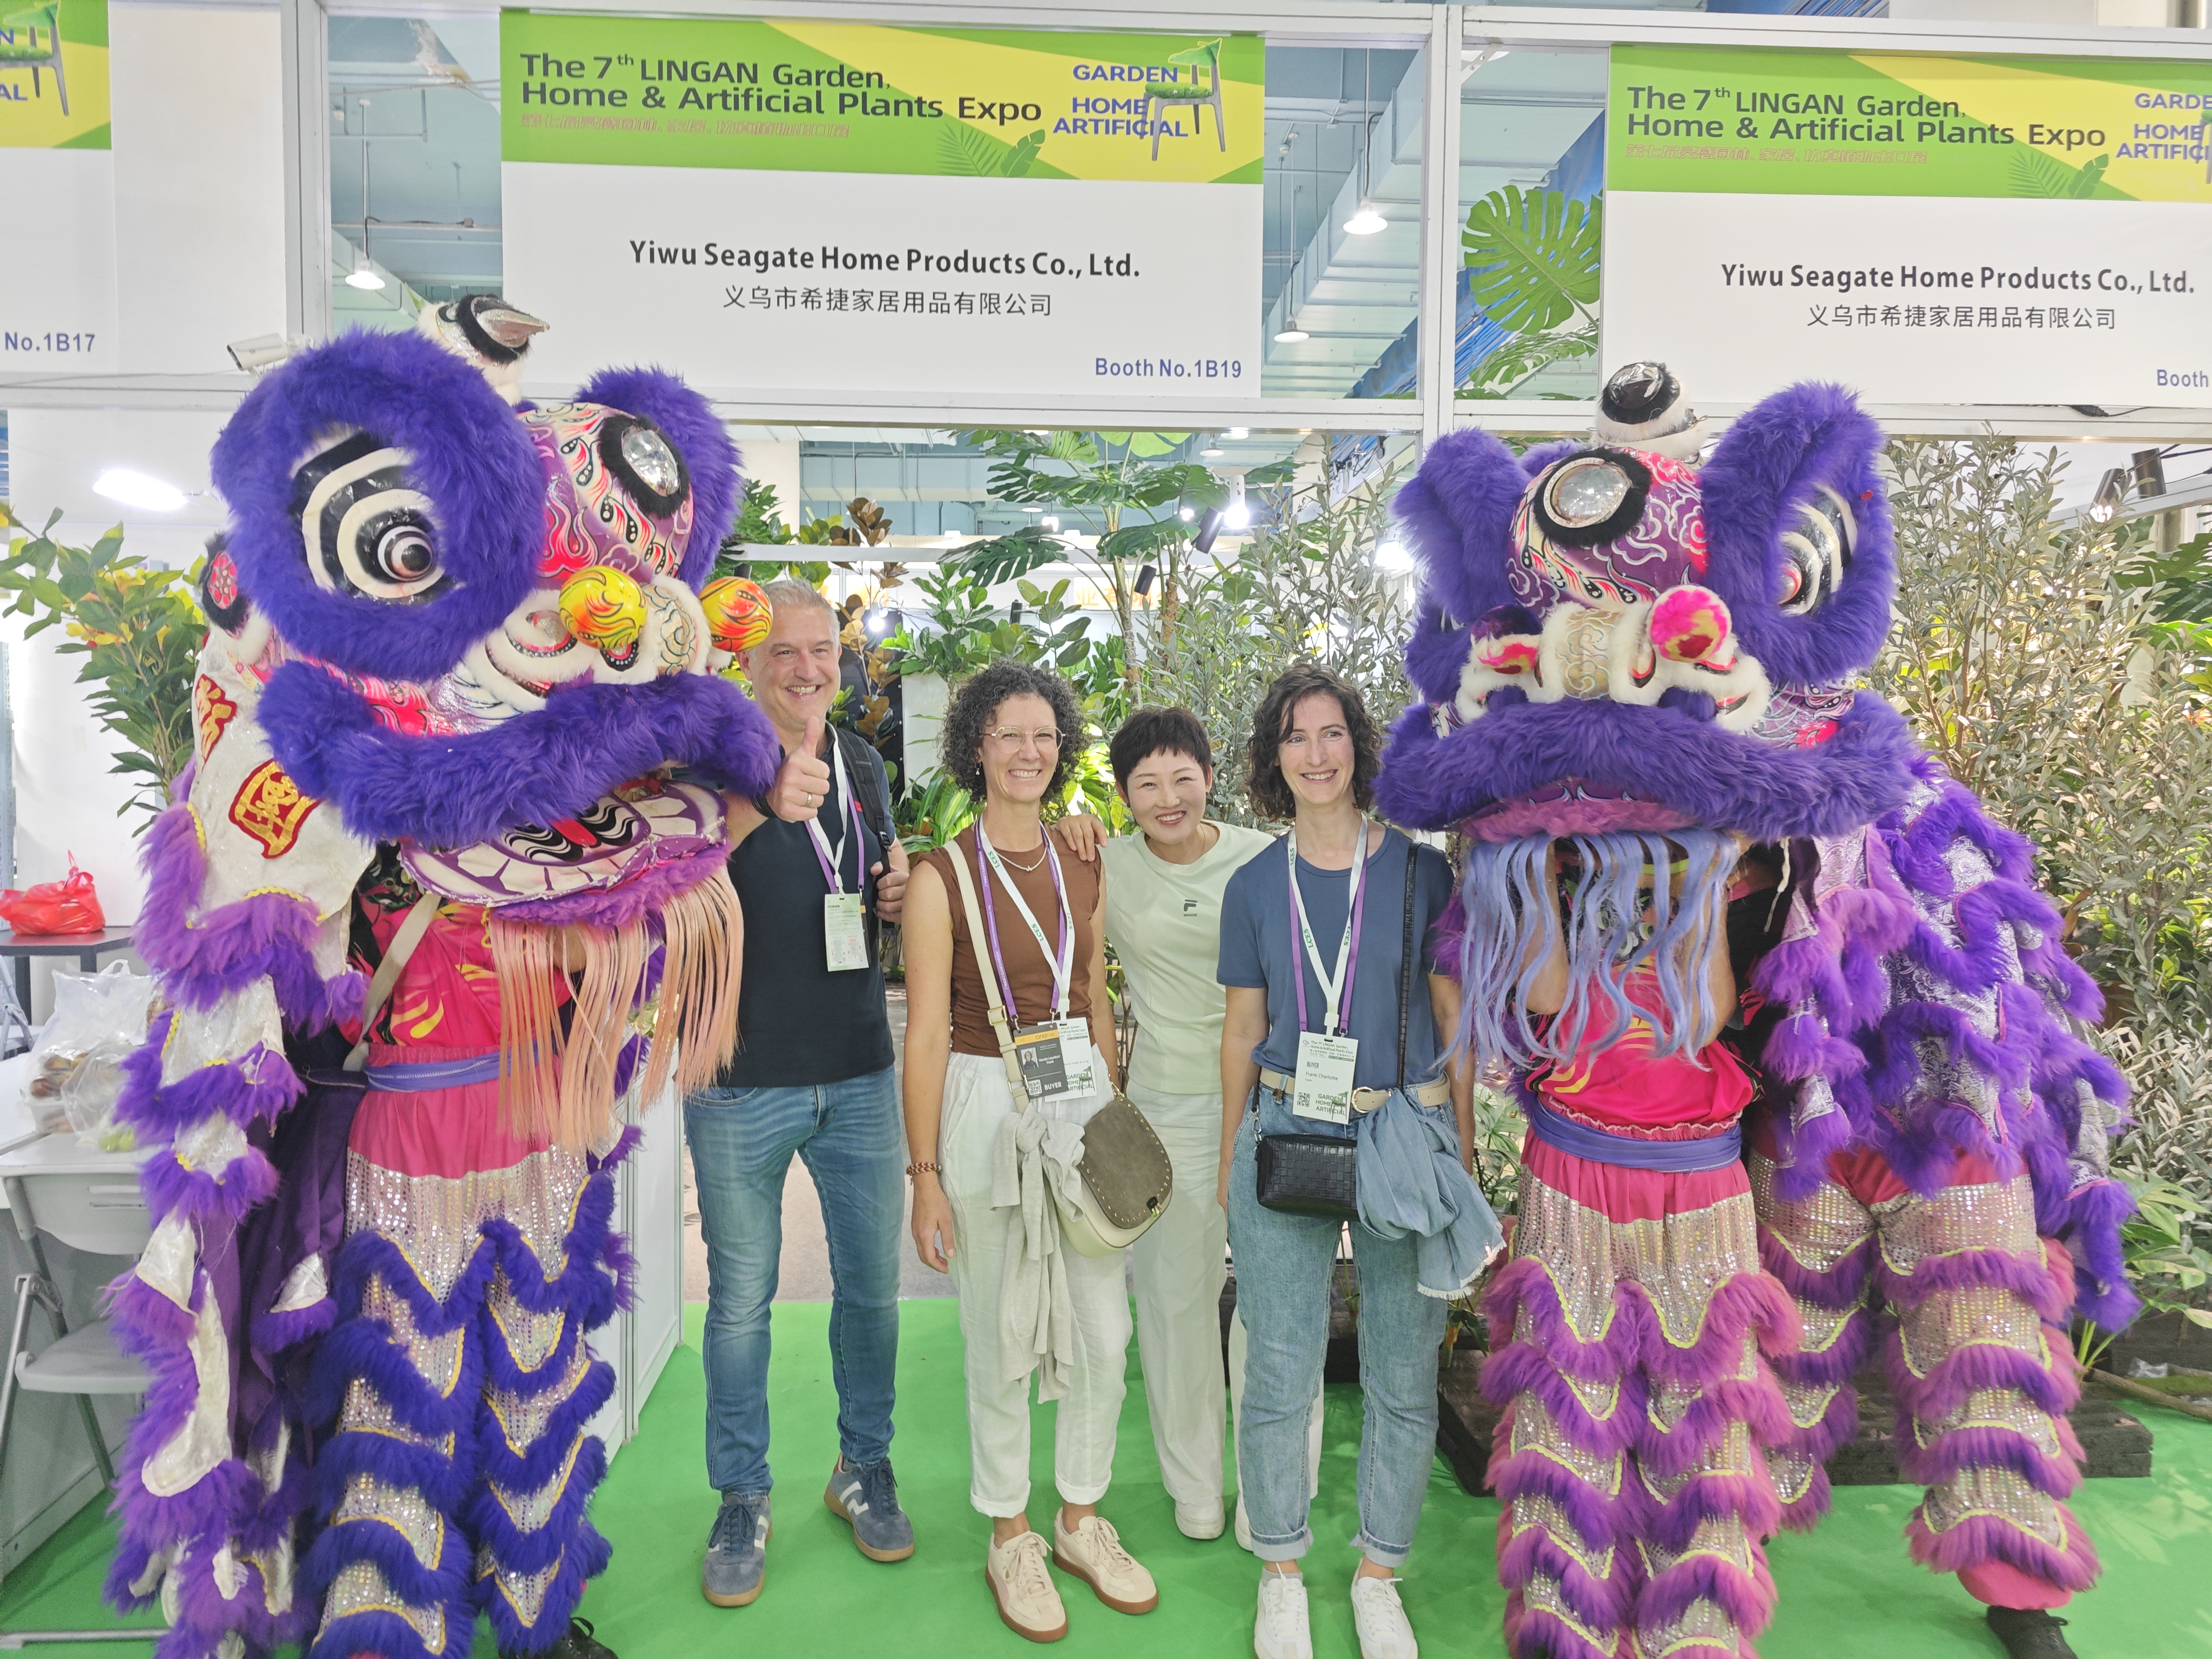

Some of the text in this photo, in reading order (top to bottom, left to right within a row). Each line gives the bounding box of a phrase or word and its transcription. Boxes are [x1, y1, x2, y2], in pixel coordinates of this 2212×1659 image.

[520, 52, 891, 90] The 7th LINGAN Garden,
[1073, 64, 1178, 83] GARDEN
[522, 81, 1042, 127] Home & Artificial Plants Expo
[1072, 96, 1148, 115] HOME
[1627, 85, 1966, 118] The 7th LINGAN Garden,
[1053, 117, 1189, 137] ARTIFICIAL
[1628, 113, 2106, 151] Home & Artificial Plants Expo
[2134, 123, 2203, 141] HOME
[629, 239, 1140, 280] Yiwu Seagate Home Products Co., Ltd.
[1721, 263, 2195, 295] Yiwu Seagate Home Products Co., Ltd.
[723, 284, 1051, 316] 义乌市希捷家居用品有限公司
[1806, 304, 2115, 330] 义乌市希捷家居用品有限公司
[4, 331, 96, 353] No.1B17
[1095, 357, 1242, 380] Booth No.1B19
[2156, 369, 2209, 388] Booth
[988, 851, 1000, 868] LCES
[1031, 923, 1044, 941] LCES
[1304, 928, 1314, 948] LCES
[1044, 1081, 1062, 1091] BUYER
[1318, 1094, 1343, 1103] GARDEN
[1316, 1106, 1347, 1116] ARTIFICIAL
